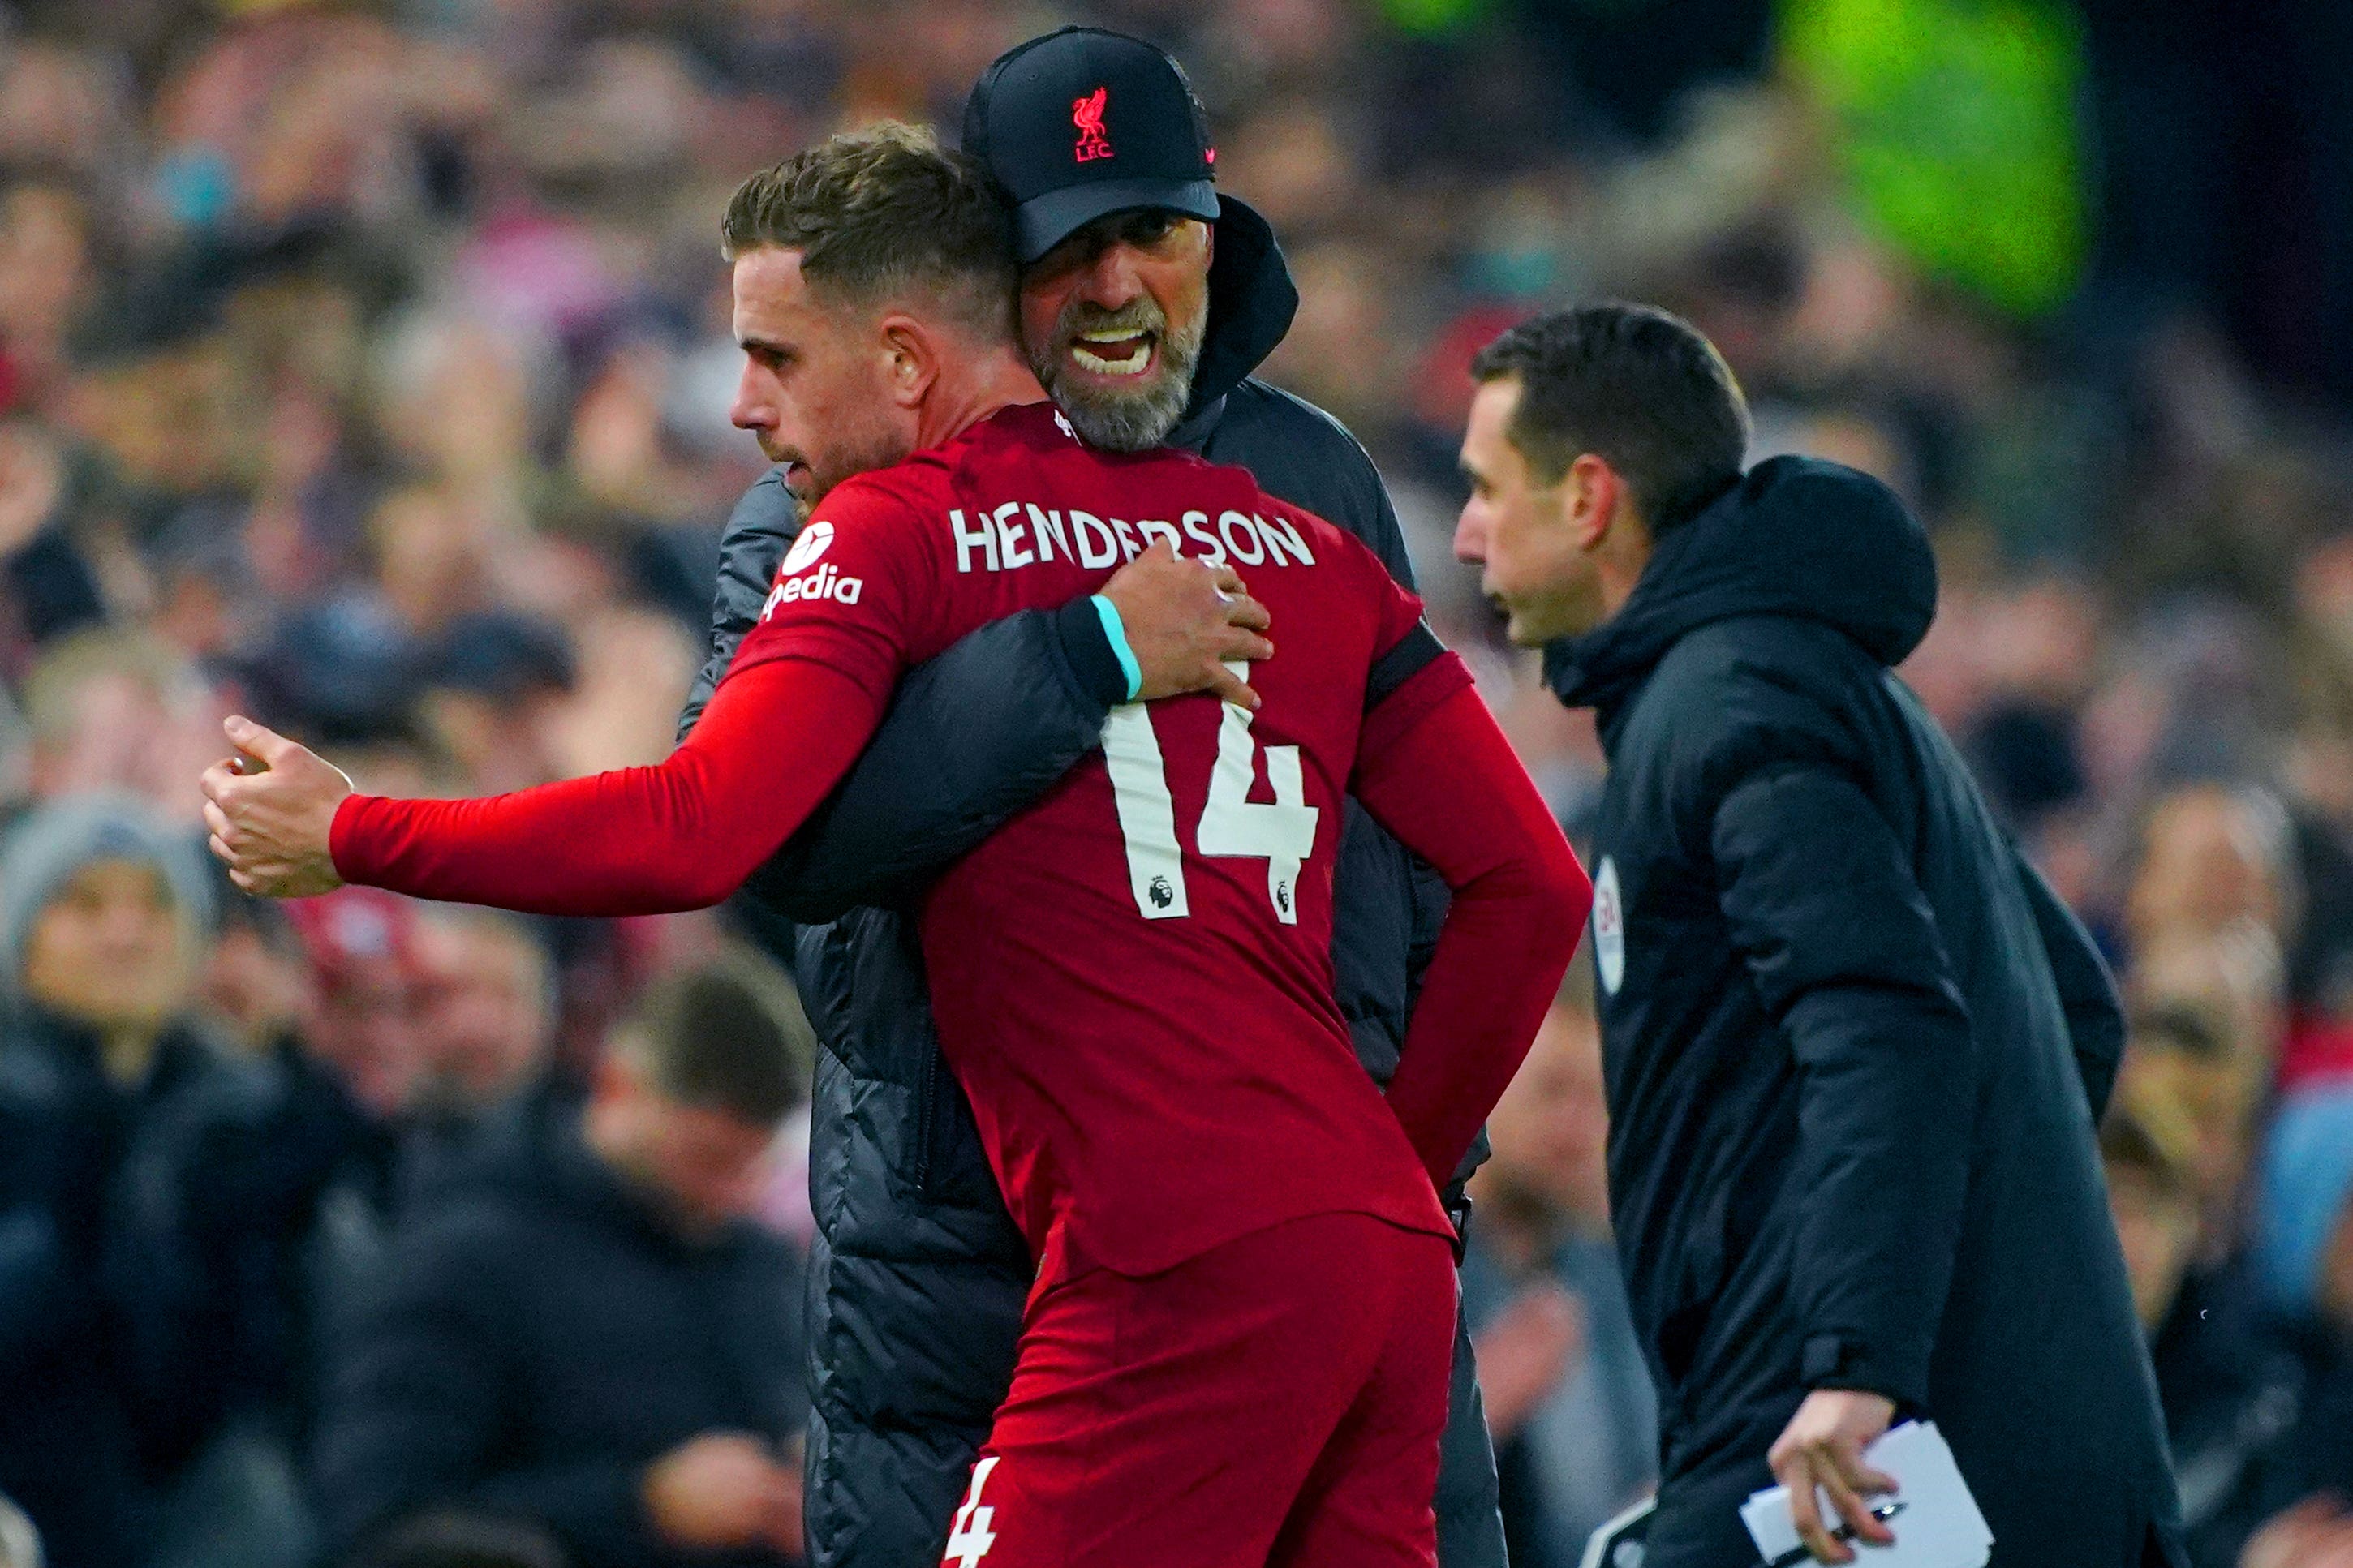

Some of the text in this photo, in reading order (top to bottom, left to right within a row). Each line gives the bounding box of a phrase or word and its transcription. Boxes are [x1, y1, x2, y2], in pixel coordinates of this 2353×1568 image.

[1076, 142, 1114, 162] LFC
[949, 500, 1316, 573] HENDERSON
[763, 562, 863, 622] pedia
[1100, 661, 1319, 925] 14
